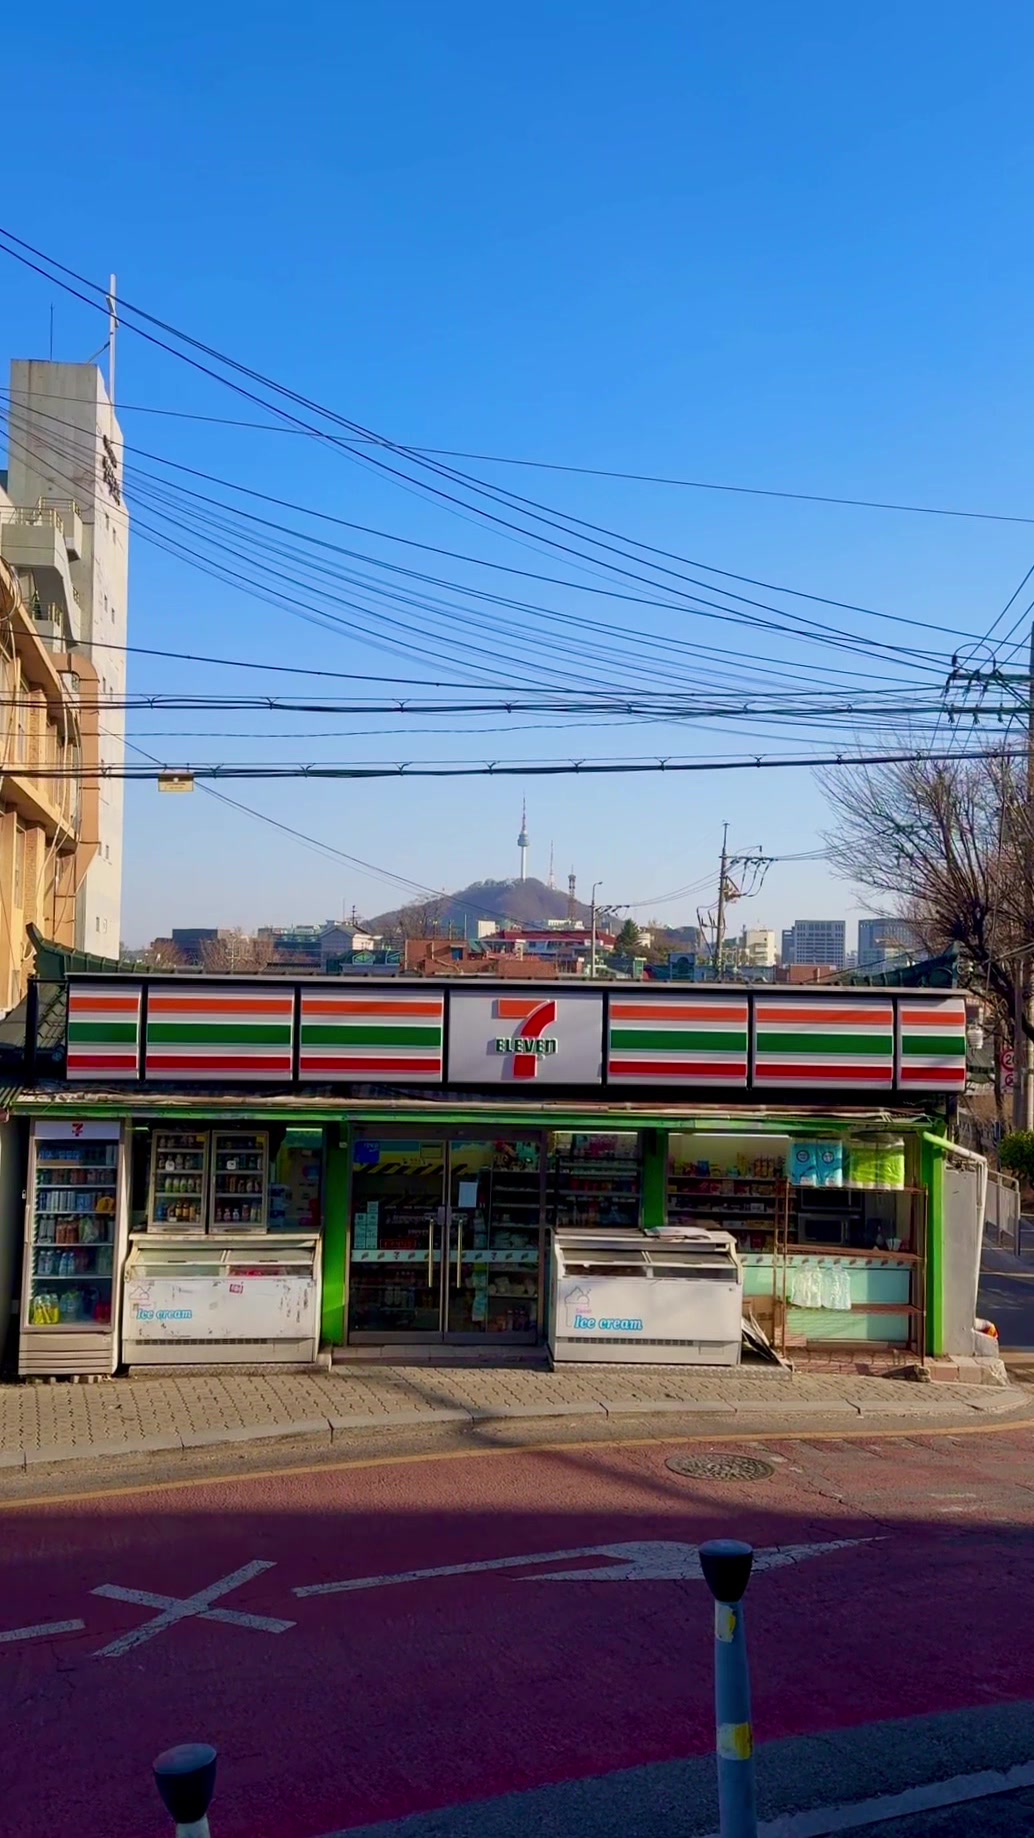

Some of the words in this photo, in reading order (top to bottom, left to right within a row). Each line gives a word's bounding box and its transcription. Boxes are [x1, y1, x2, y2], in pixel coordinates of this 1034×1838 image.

[497, 998, 557, 1079] 7
[136, 1309, 154, 1320] Ice
[156, 1309, 192, 1320] cream
[574, 1315, 596, 1329] Ice
[599, 1318, 643, 1330] cream
